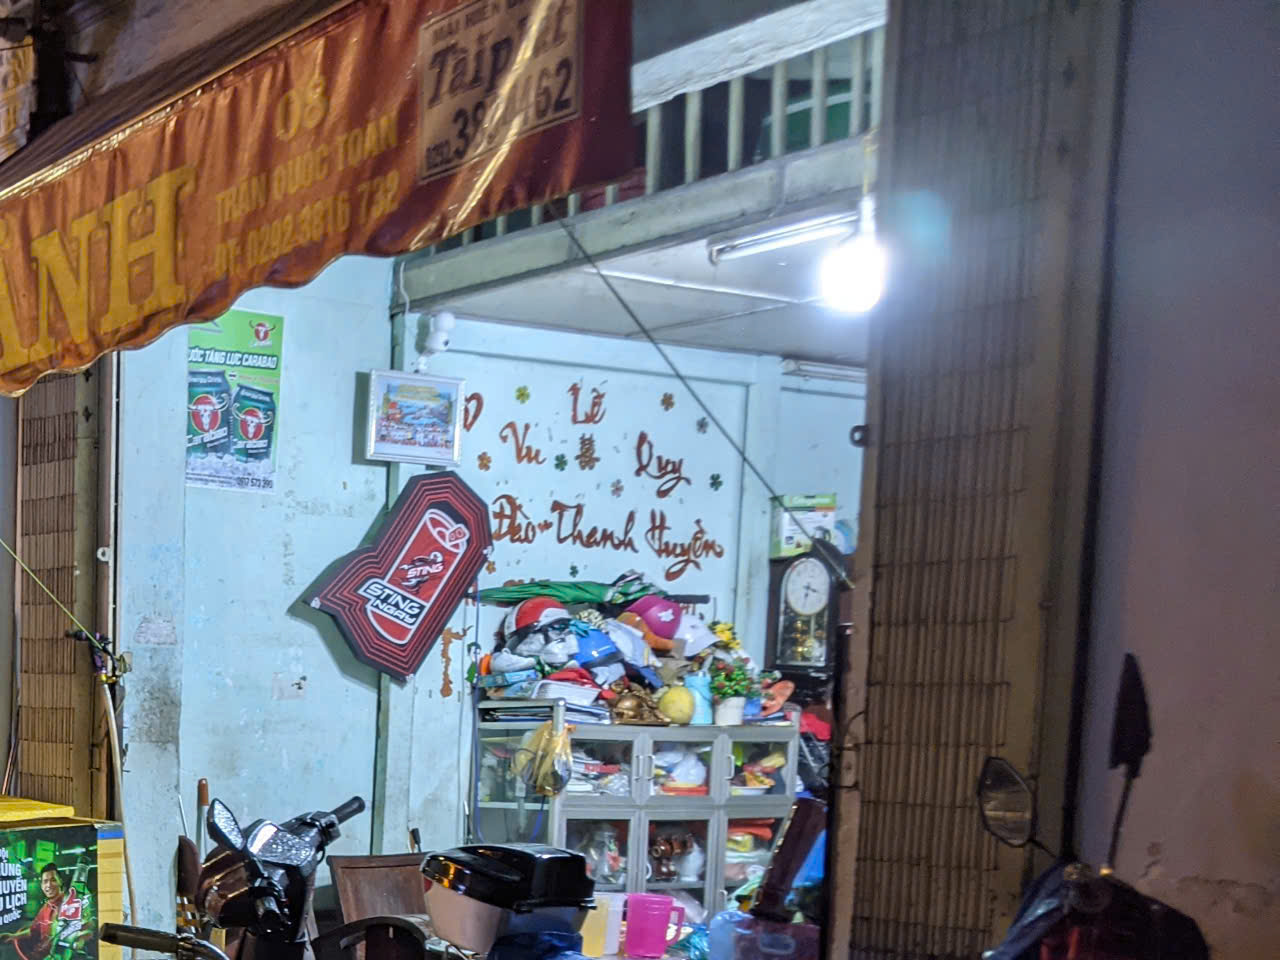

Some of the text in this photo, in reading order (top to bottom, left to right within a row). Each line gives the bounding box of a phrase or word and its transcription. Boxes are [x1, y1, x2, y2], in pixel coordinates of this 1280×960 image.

[276, 75, 329, 140] 08
[242, 354, 278, 369] CARABAO
[499, 421, 547, 464] Vu
[634, 430, 691, 498] Quy
[551, 500, 639, 553] Thanh
[407, 563, 443, 578] STING
[366, 582, 420, 616] STING
[373, 600, 417, 624] NGAY
[5, 892, 27, 914] LỊCH
